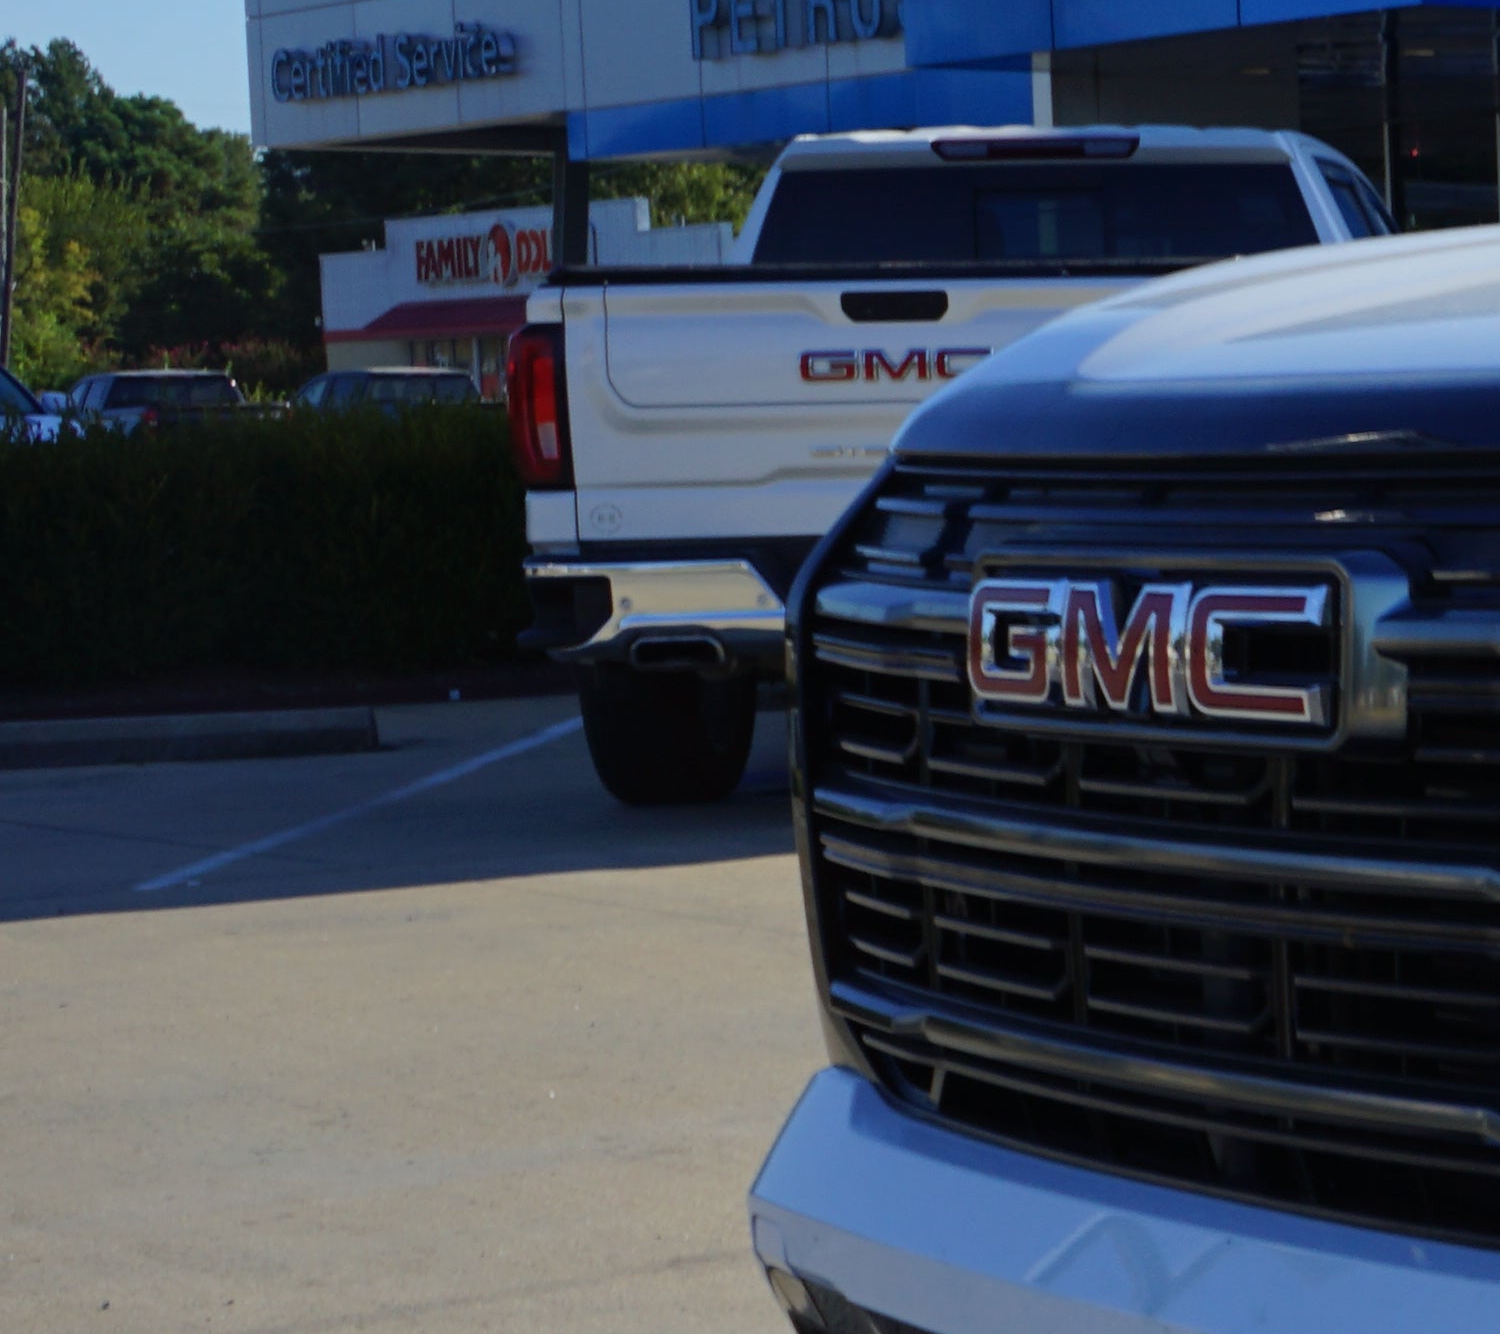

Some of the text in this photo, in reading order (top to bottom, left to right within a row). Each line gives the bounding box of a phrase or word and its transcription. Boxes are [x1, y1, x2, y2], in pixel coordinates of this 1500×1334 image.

[271, 21, 506, 103] Certified Service
[415, 234, 482, 284] FAMILY
[799, 347, 994, 383] GMC
[968, 577, 1329, 725] GMC
